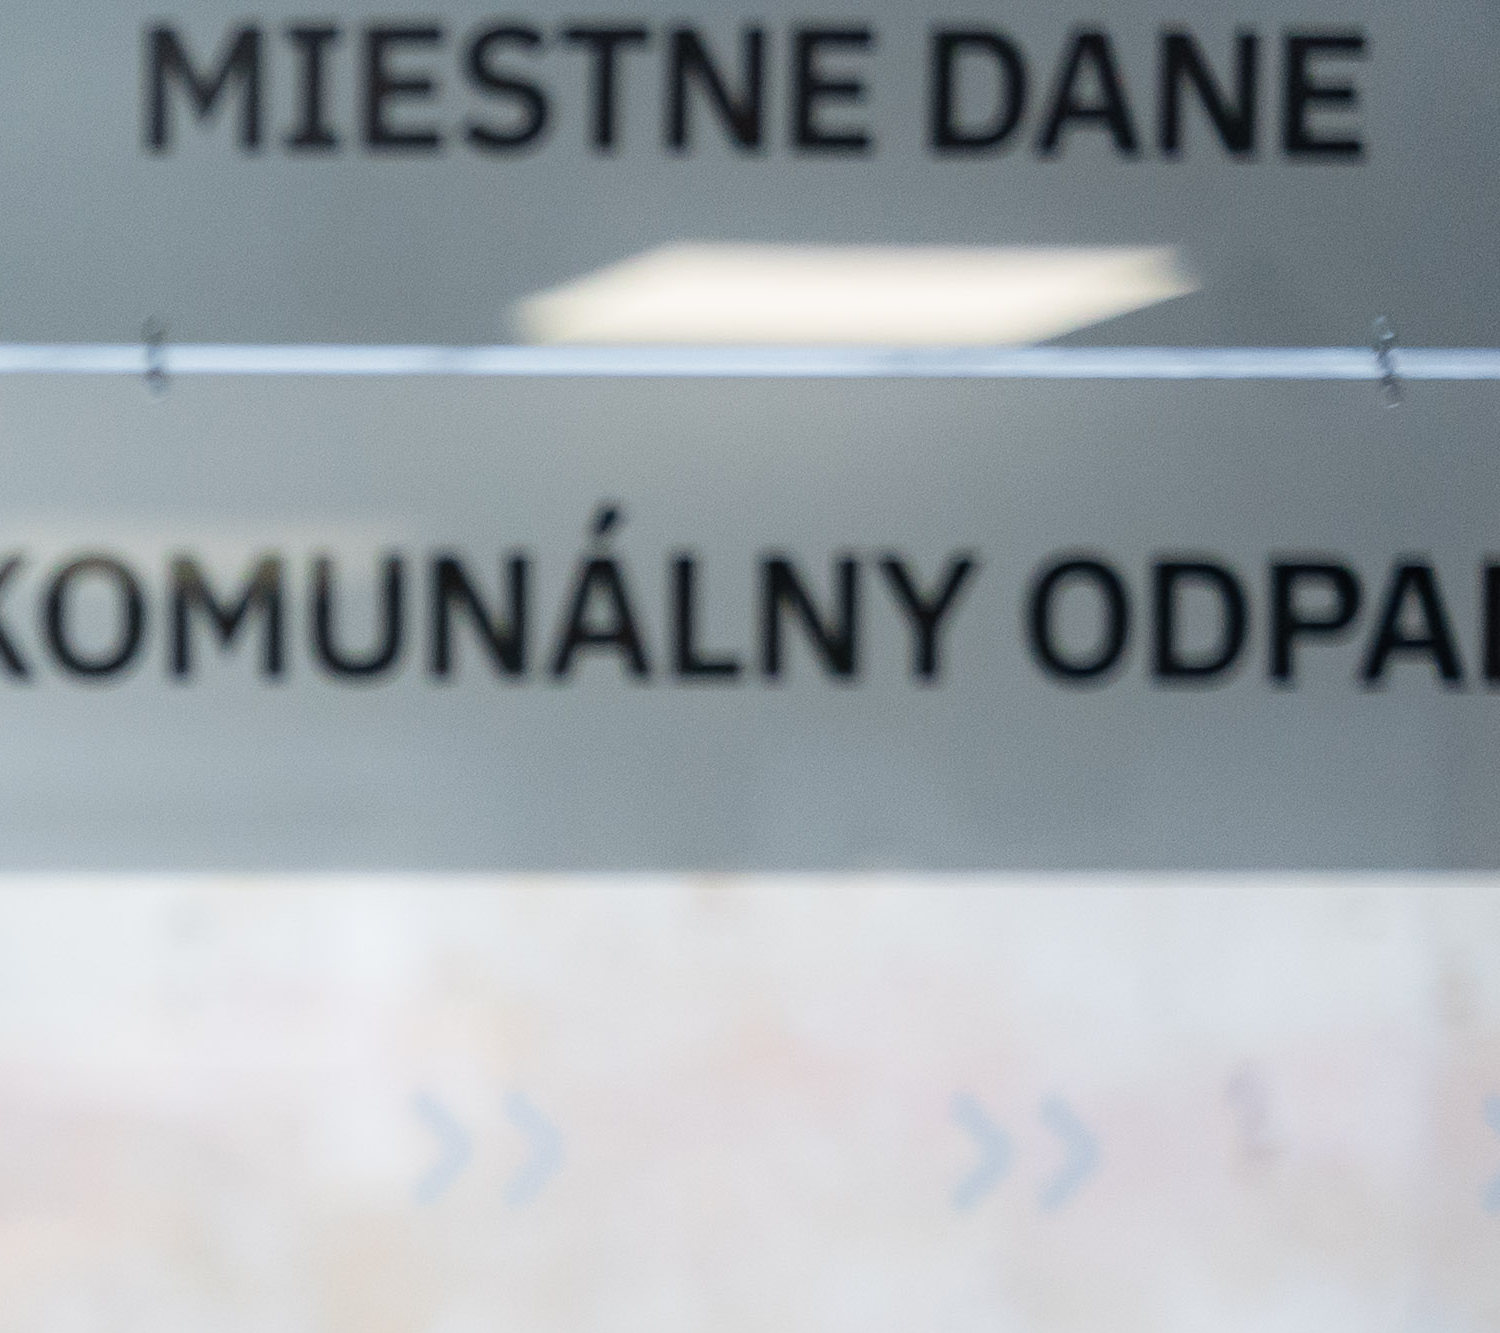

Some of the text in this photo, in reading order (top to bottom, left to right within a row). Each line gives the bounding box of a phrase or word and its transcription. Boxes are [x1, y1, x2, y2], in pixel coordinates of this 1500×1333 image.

[143, 22, 1366, 157] MIESTNE DANE
[1026, 554, 1500, 686] ODPA
